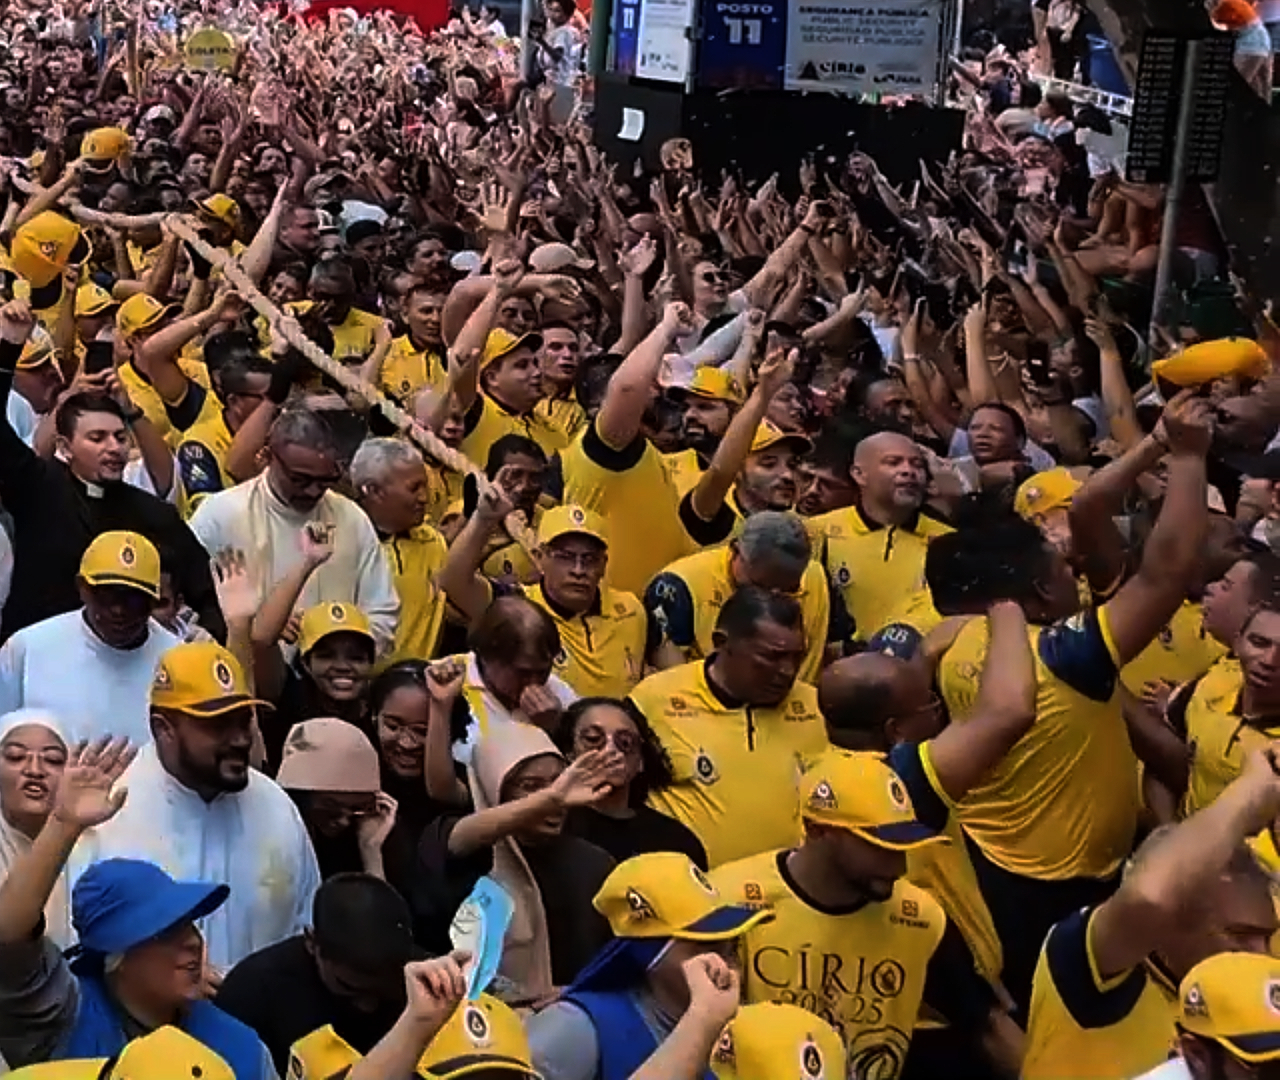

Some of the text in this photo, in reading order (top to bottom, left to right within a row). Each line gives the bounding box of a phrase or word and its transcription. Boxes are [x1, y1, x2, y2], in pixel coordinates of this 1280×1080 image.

[716, 3, 773, 14] POSTO
[726, 17, 762, 44] 11
[753, 942, 905, 998] CÍRIO
